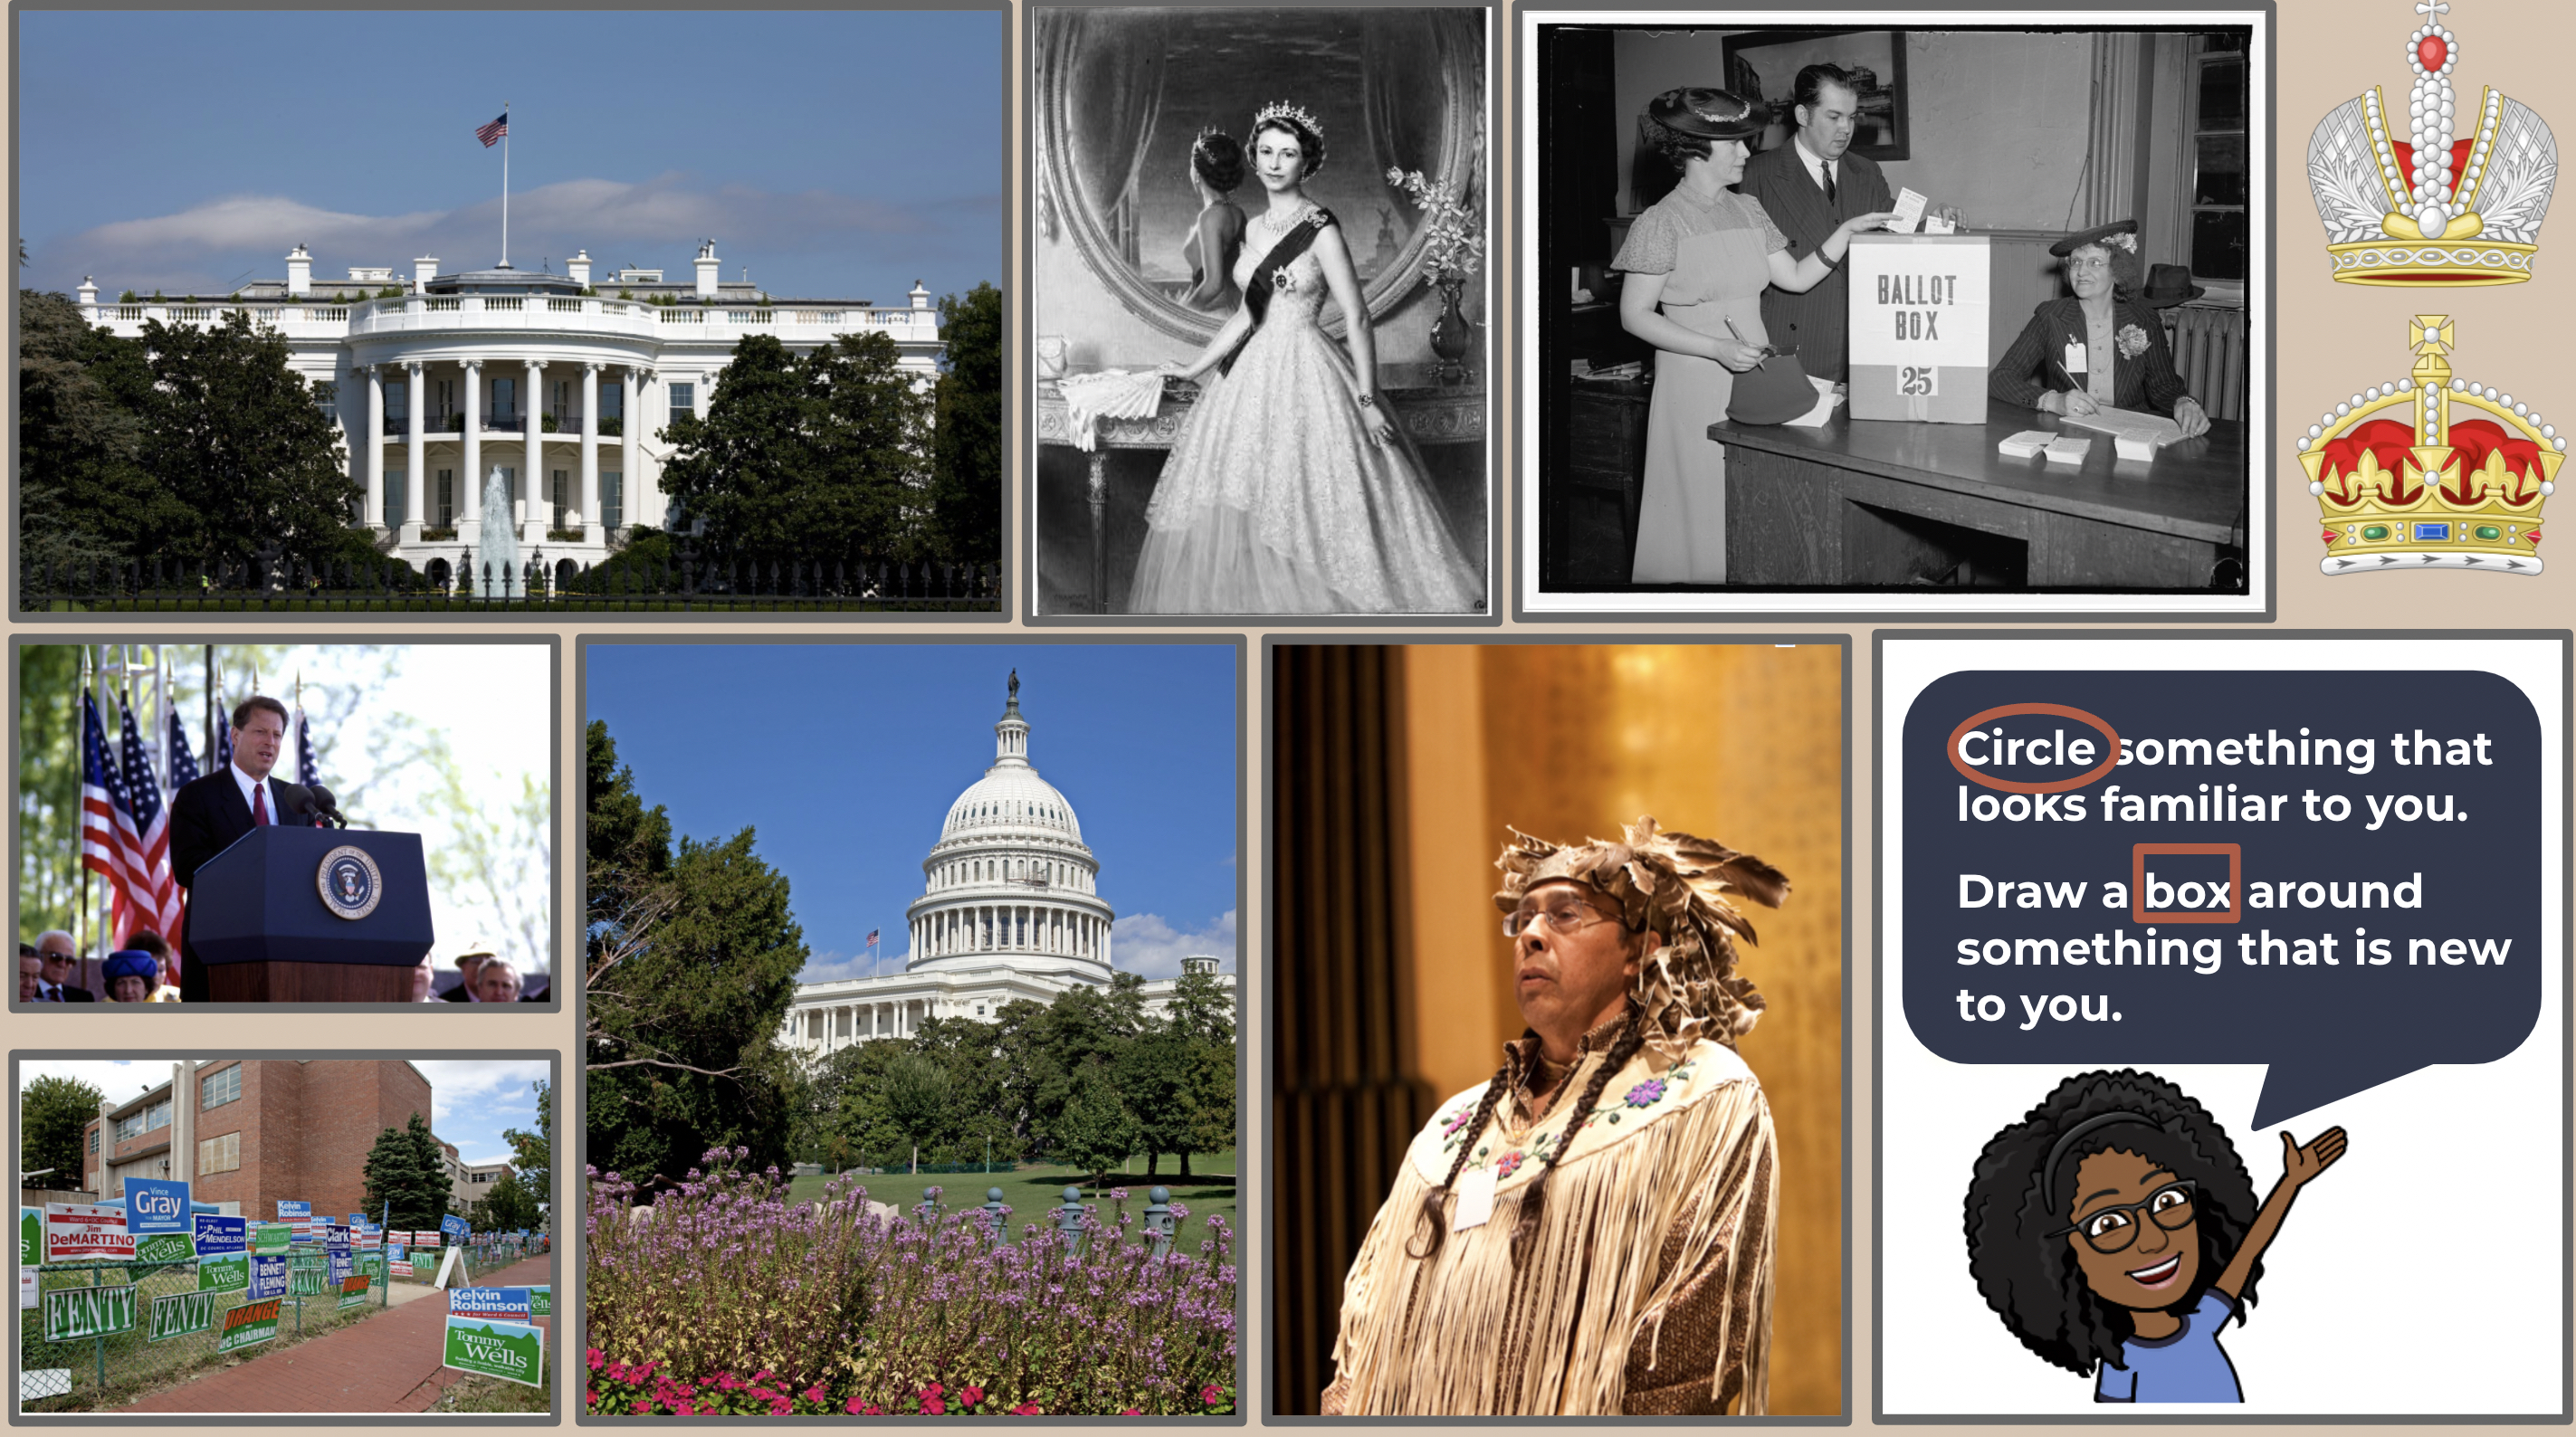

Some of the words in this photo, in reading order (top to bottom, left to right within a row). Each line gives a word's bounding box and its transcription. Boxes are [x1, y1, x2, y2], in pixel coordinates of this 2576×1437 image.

[1877, 274, 1957, 306] BALLOT
[1894, 310, 1939, 341] BOX
[1902, 366, 1932, 395] 25
[320, 848, 348, 880] PRESIDENT
[365, 859, 379, 890] UNITED
[329, 901, 346, 915] SEAL
[357, 894, 377, 917] STATES
[150, 1187, 169, 1195] Vince
[135, 1191, 182, 1219] Gray
[278, 1201, 301, 1210] Kelvin
[206, 1224, 224, 1234] PHIL
[327, 1227, 350, 1242] Clark
[445, 1220, 462, 1231] Gray
[51, 1232, 135, 1247] DeMARTINO
[205, 1234, 245, 1243] MENDELSON
[142, 1241, 186, 1261] Wells
[205, 1264, 235, 1274] Tommy
[212, 1270, 244, 1285] Wells
[260, 1262, 285, 1277] BENNETT
[449, 1289, 501, 1300] Kelvin
[48, 1287, 136, 1339] FENTY
[150, 1291, 215, 1338] FENTY
[224, 1299, 282, 1331] ORANGE
[451, 1299, 529, 1312] Robinson
[234, 1325, 277, 1345] CHAIRMAN
[454, 1330, 506, 1350] Tommy
[463, 1342, 528, 1368] Wells
[455, 1356, 472, 1365] Building
[493, 1363, 515, 1371] walkable
[516, 1366, 525, 1375] city
